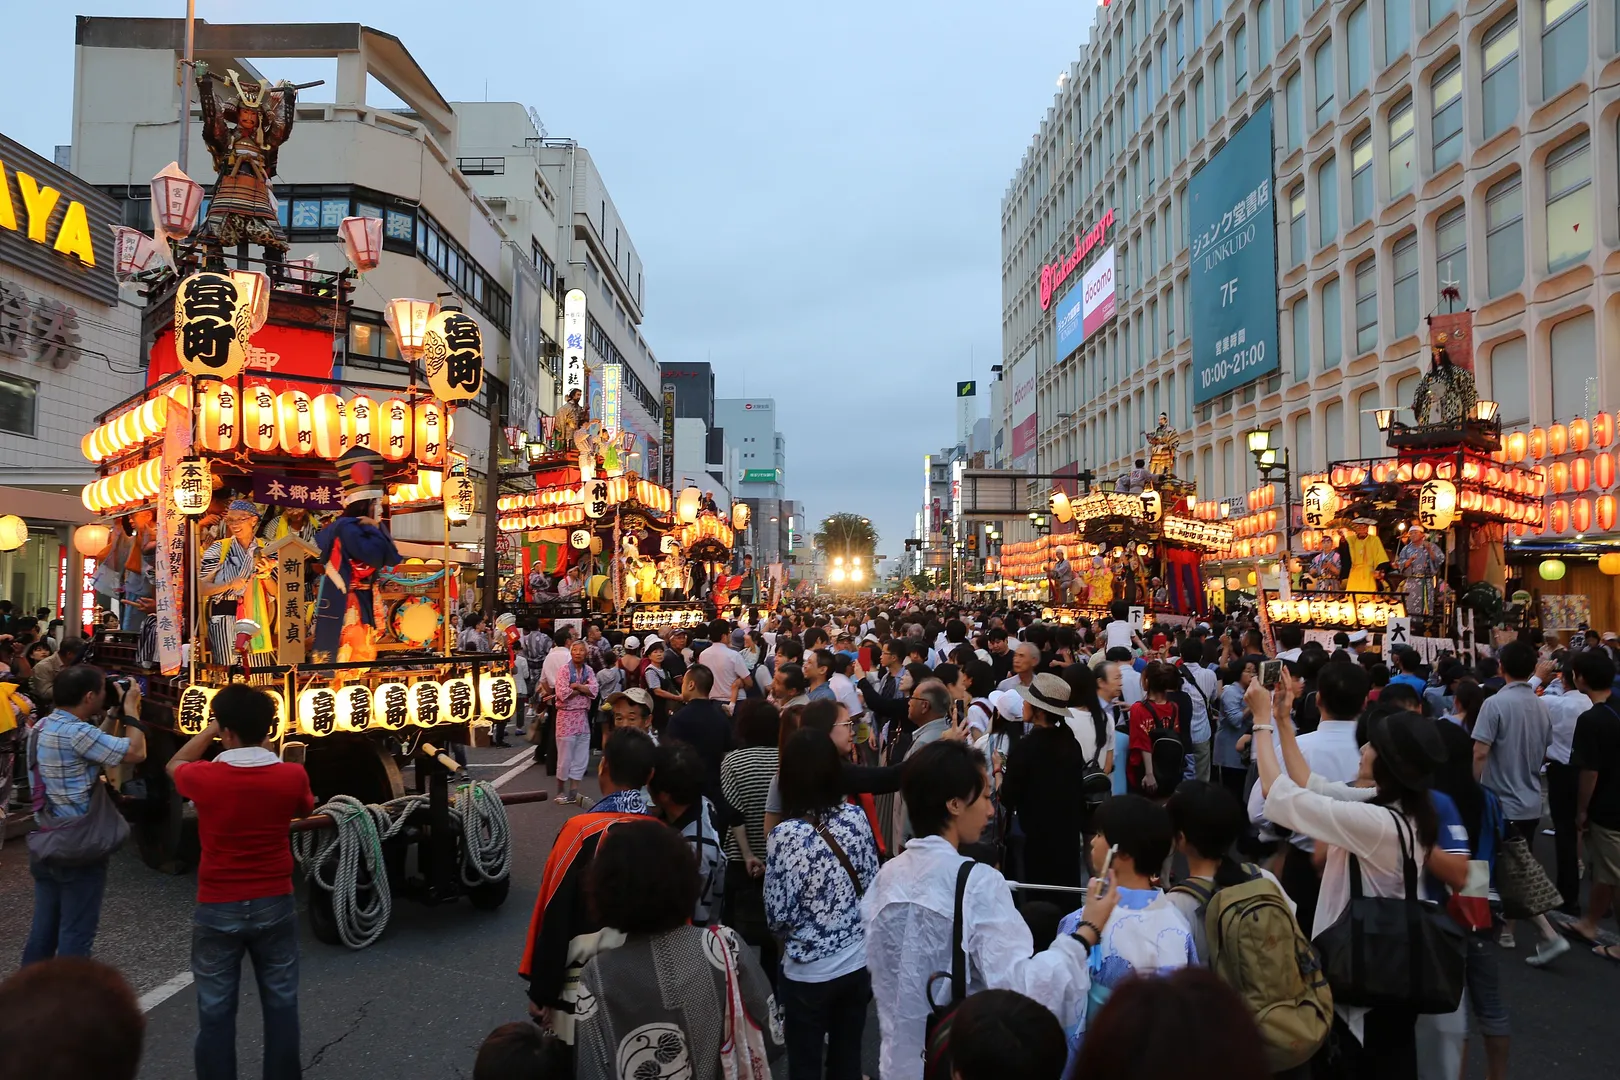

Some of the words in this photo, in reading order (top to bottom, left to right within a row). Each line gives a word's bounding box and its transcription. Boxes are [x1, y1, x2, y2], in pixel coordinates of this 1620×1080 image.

[1193, 178, 1269, 258] ジュンク堂書店
[1051, 207, 1114, 292] Takashimaya
[1204, 223, 1256, 274] JUNKUDO
[1085, 267, 1112, 304] docomo
[1220, 277, 1239, 308] 7F
[183, 274, 238, 368] 宮町
[1215, 328, 1246, 357] 営業時間
[444, 313, 482, 393] 宮町
[1014, 376, 1035, 405] docomo
[217, 391, 235, 439] 宮町
[255, 391, 275, 439] 宮町
[294, 397, 312, 445] 宮町
[353, 404, 371, 446] 宮町
[389, 405, 405, 449] 宮町
[424, 411, 440, 456] 宮町
[1305, 485, 1323, 526] 大門町
[1421, 482, 1438, 526] 大門町
[282, 558, 302, 644] 新田義貞
[1131, 609, 1142, 623] 下
[1391, 622, 1406, 642] 大
[181, 688, 207, 732] 宮町
[312, 691, 335, 734] 宮町
[350, 687, 371, 729] 宮町
[385, 685, 407, 728] 宮町
[417, 683, 439, 725] 宮町
[449, 681, 472, 720] 宮町
[491, 678, 513, 717] 宮町
